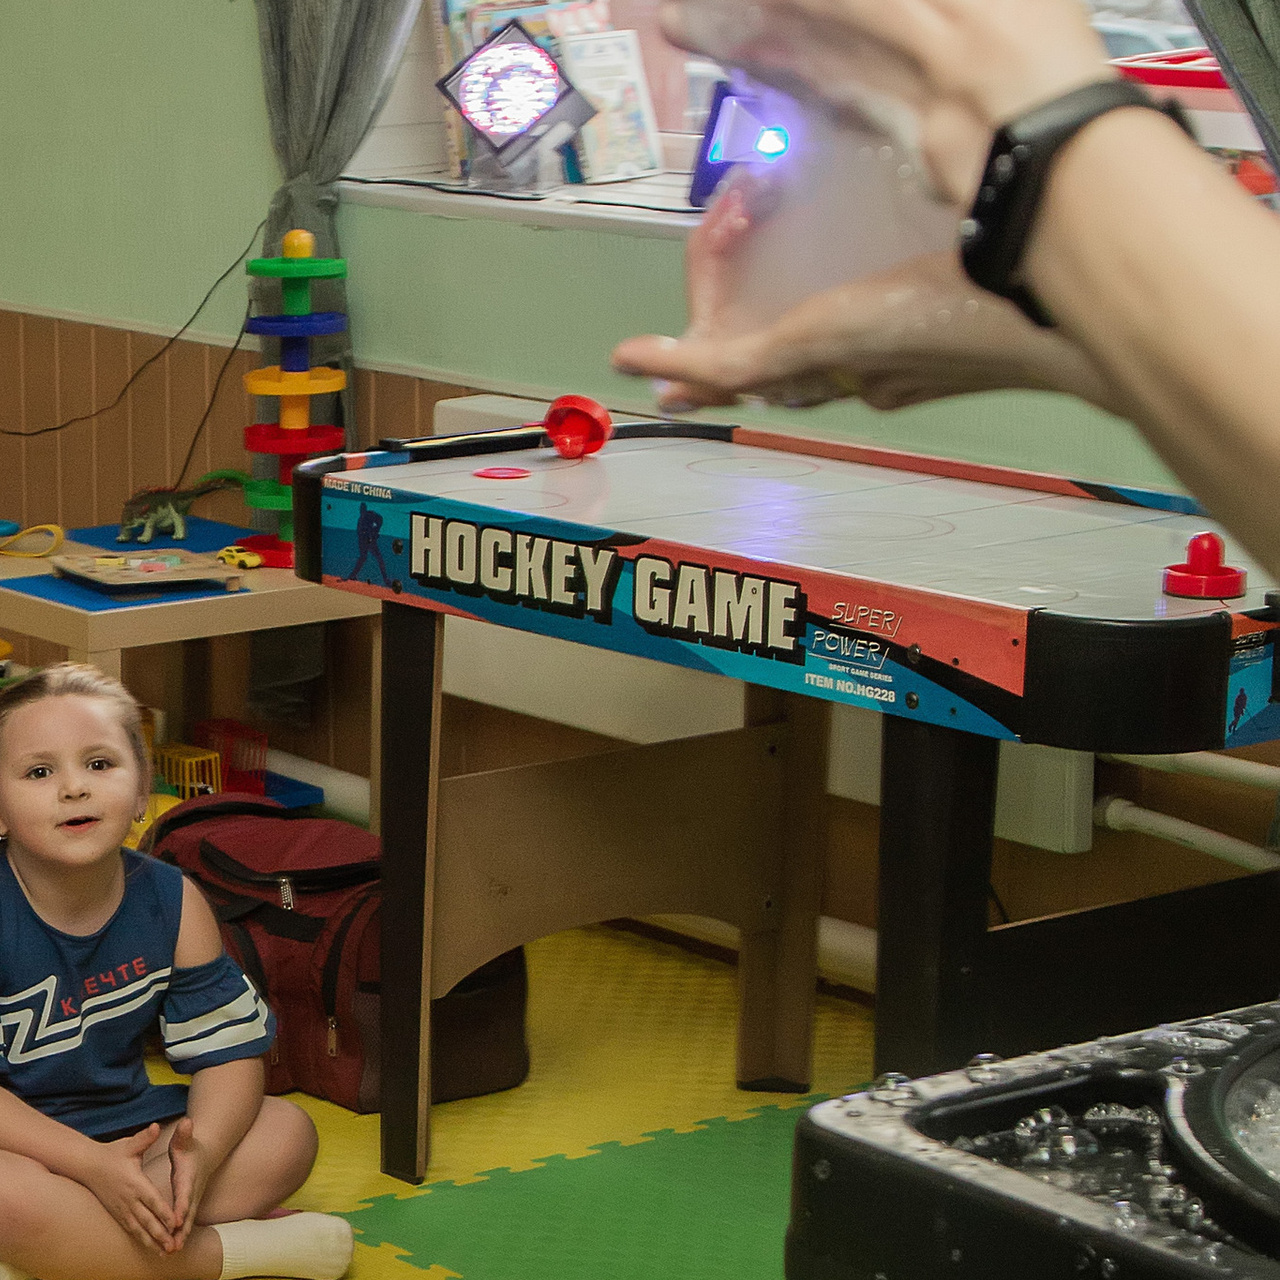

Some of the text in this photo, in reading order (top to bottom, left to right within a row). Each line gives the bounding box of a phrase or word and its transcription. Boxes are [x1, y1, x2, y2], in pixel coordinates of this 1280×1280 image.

[324, 478, 392, 499] MADE IN CHINA
[410, 513, 799, 652] HOCKEY GAME
[831, 602, 896, 631] SUPER
[812, 631, 881, 661] POWER
[828, 663, 893, 683] SPORT GAME SERIES
[805, 673, 896, 703] ITEM NO.HG228
